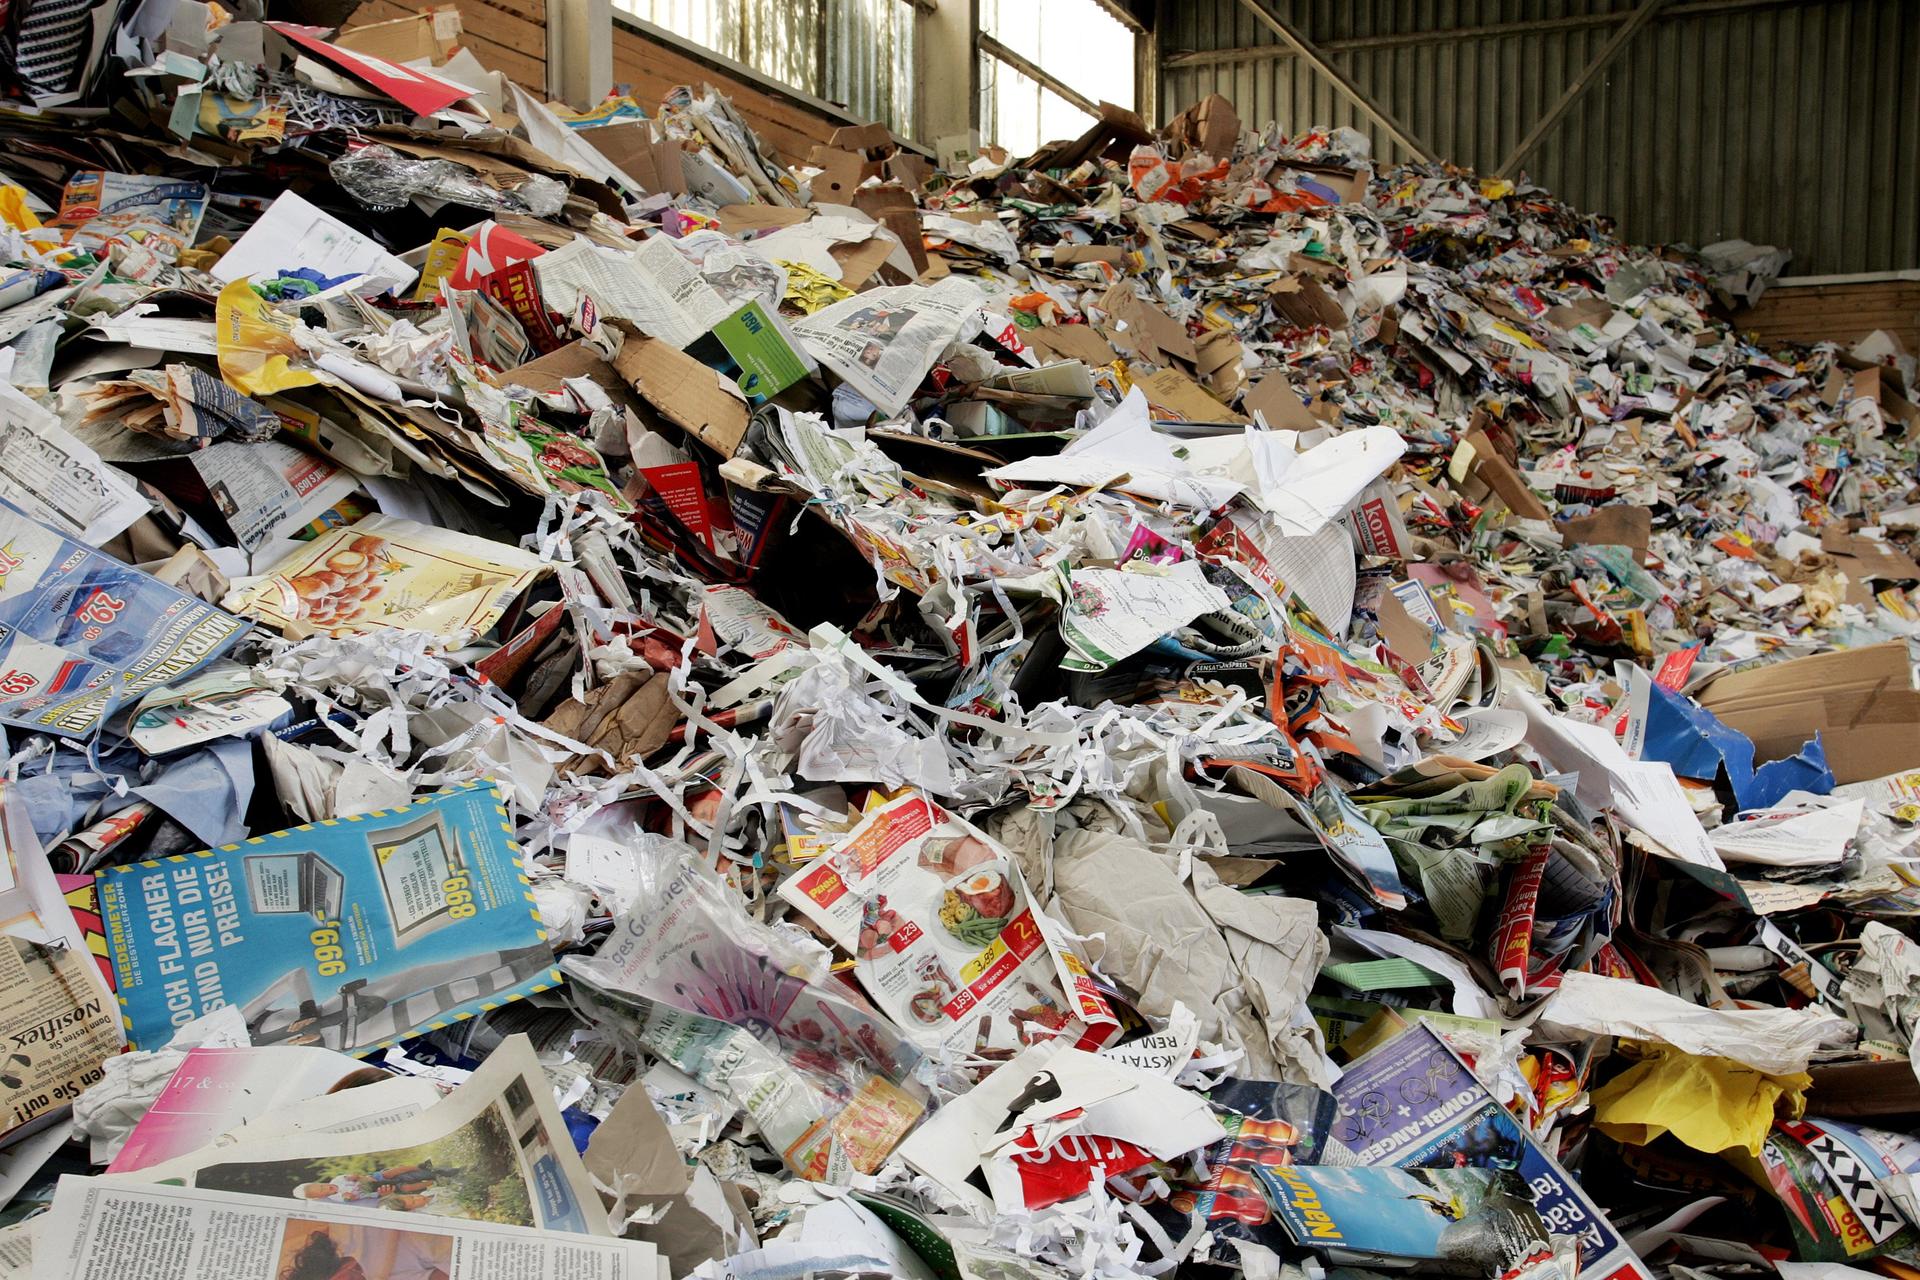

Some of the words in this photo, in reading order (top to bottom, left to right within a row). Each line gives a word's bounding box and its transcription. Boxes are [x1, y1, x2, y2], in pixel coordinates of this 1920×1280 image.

[262, 511, 287, 533] Radio
[1363, 500, 1397, 557] korre
[131, 605, 209, 673] MARKENMATRATZEN
[173, 866, 202, 907] DIE
[204, 861, 246, 947] PREISE!
[115, 881, 141, 970] BESTSELLERZONE
[142, 872, 185, 975] FLACHER
[184, 910, 212, 959] NUR
[896, 922, 918, 942] 1,29
[134, 970, 143, 986] DIE
[985, 967, 1005, 985] sparen
[163, 979, 196, 1029] OCH
[952, 991, 973, 1012] 1,69
[14, 998, 102, 1048] Nosiflex
[63, 1025, 87, 1043] testen
[90, 1015, 111, 1029] Dann
[50, 1039, 63, 1050] Sie
[80, 1064, 106, 1082] en
[53, 1080, 80, 1099] Sie
[748, 1079, 777, 1112] ATIS
[14, 1096, 49, 1122] auf!
[1484, 1106, 1499, 1120] Die
[1357, 1083, 1492, 1167] KOMBI-ANGEB
[1434, 1114, 1487, 1156] Fahrrad-Saison
[1400, 1151, 1428, 1168] eröffne
[1425, 1146, 1437, 1157] ist
